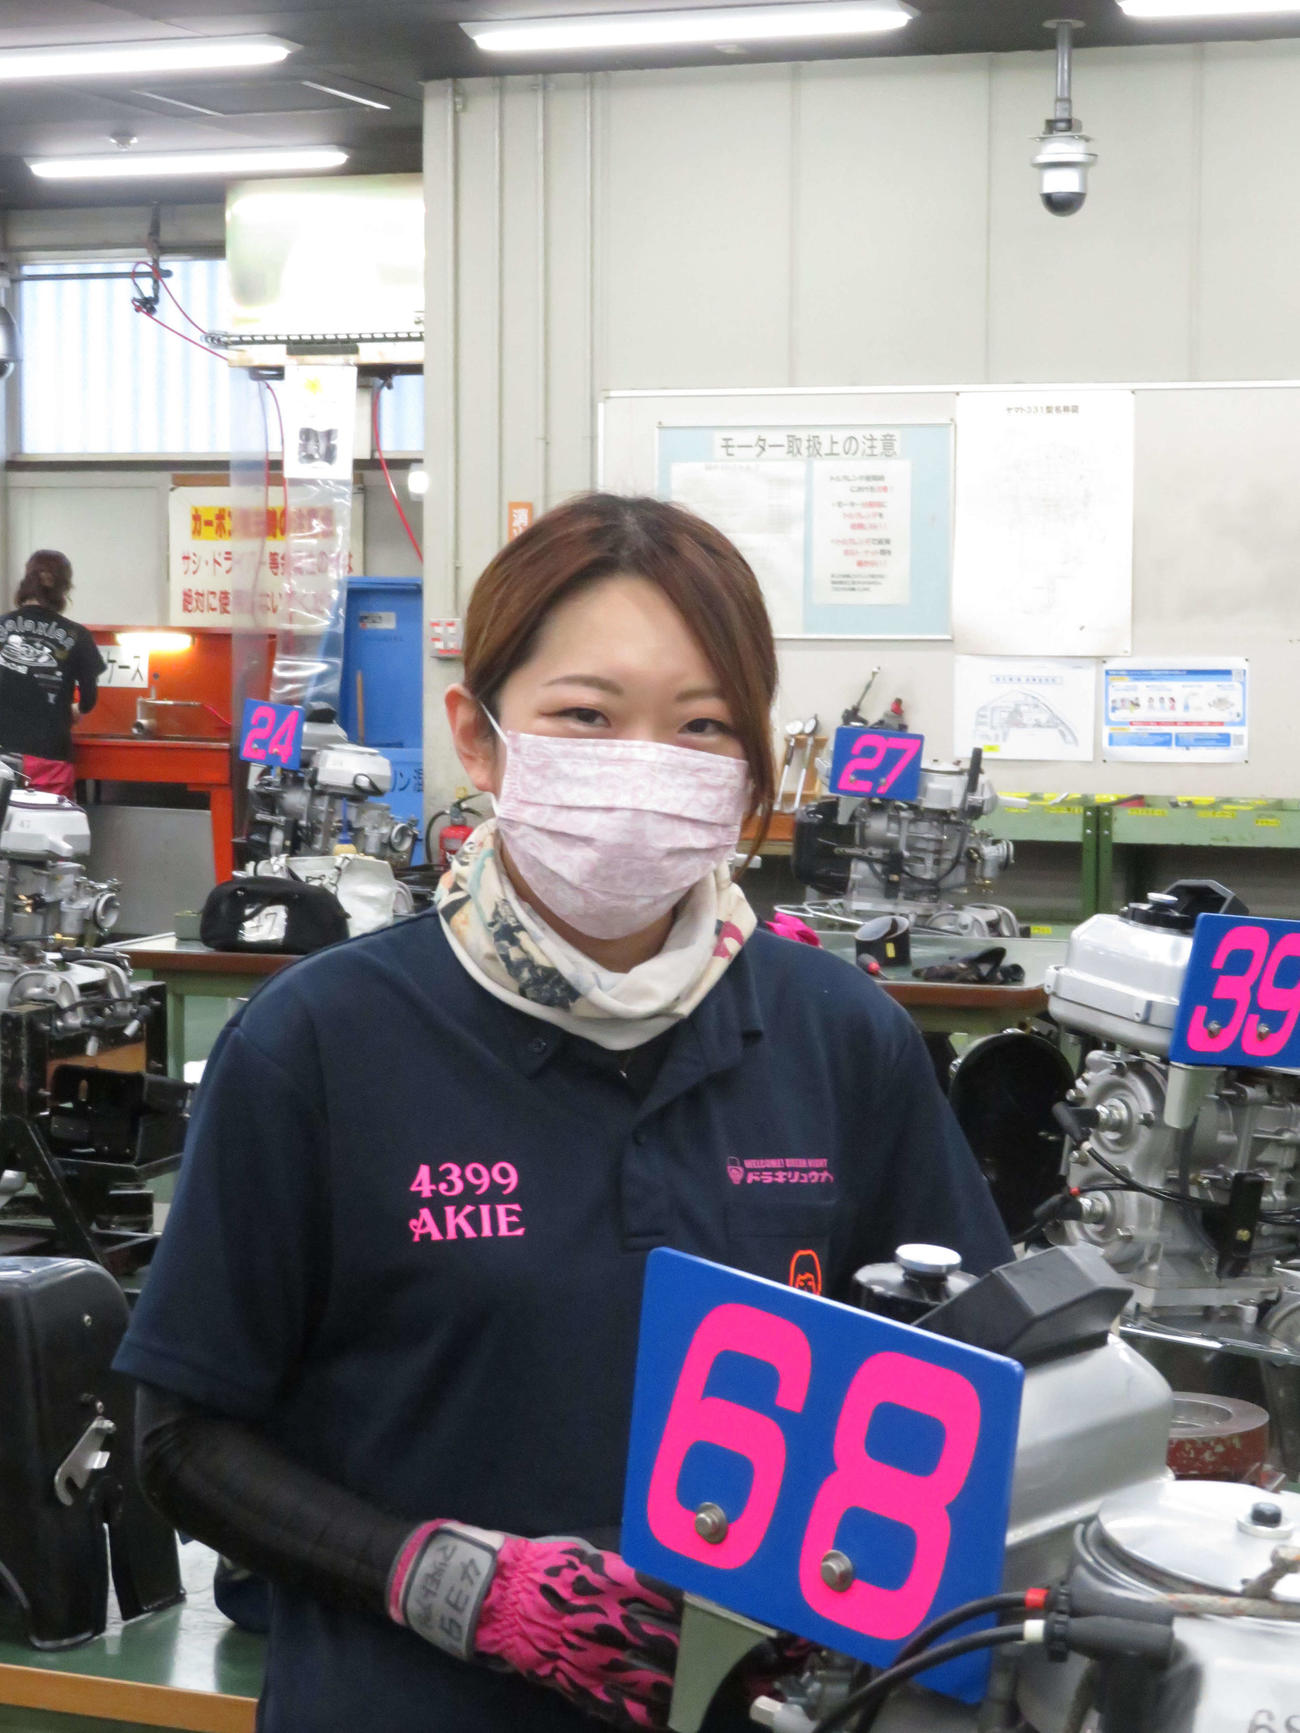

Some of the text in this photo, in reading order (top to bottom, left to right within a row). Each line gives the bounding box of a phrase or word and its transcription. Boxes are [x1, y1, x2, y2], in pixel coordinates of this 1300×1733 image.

[720, 434, 897, 458] モーター取扱上の注意
[243, 706, 299, 763] 24
[838, 734, 921, 794] 27
[1187, 926, 1300, 1056] 39
[410, 1161, 518, 1198] 4399
[409, 1203, 526, 1242] AKIE
[647, 1303, 981, 1641] 68
